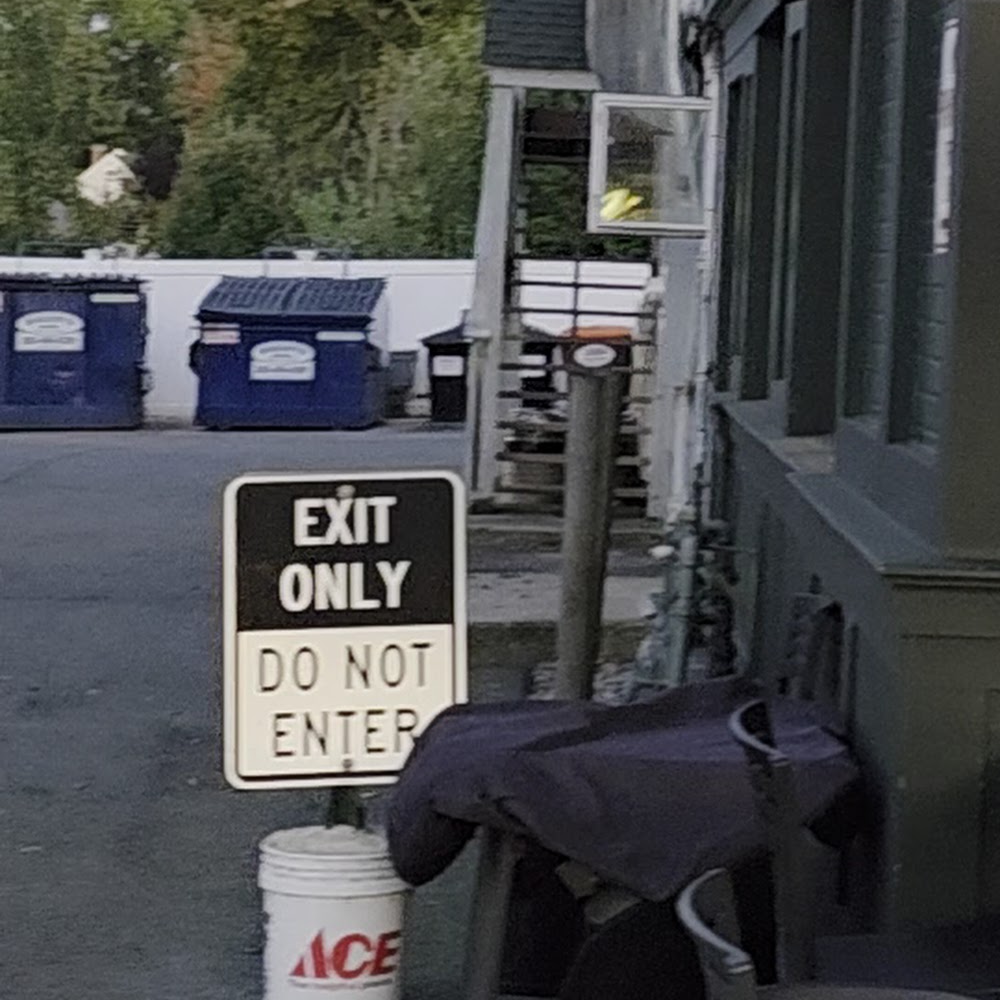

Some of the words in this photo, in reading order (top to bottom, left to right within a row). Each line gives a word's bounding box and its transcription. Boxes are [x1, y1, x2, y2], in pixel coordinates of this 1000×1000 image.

[294, 495, 398, 547] EXIT
[278, 560, 412, 613] ONLY
[258, 646, 319, 692] DO
[344, 643, 434, 689] NOT
[272, 708, 420, 758] ENTER
[288, 928, 400, 979] ACE
